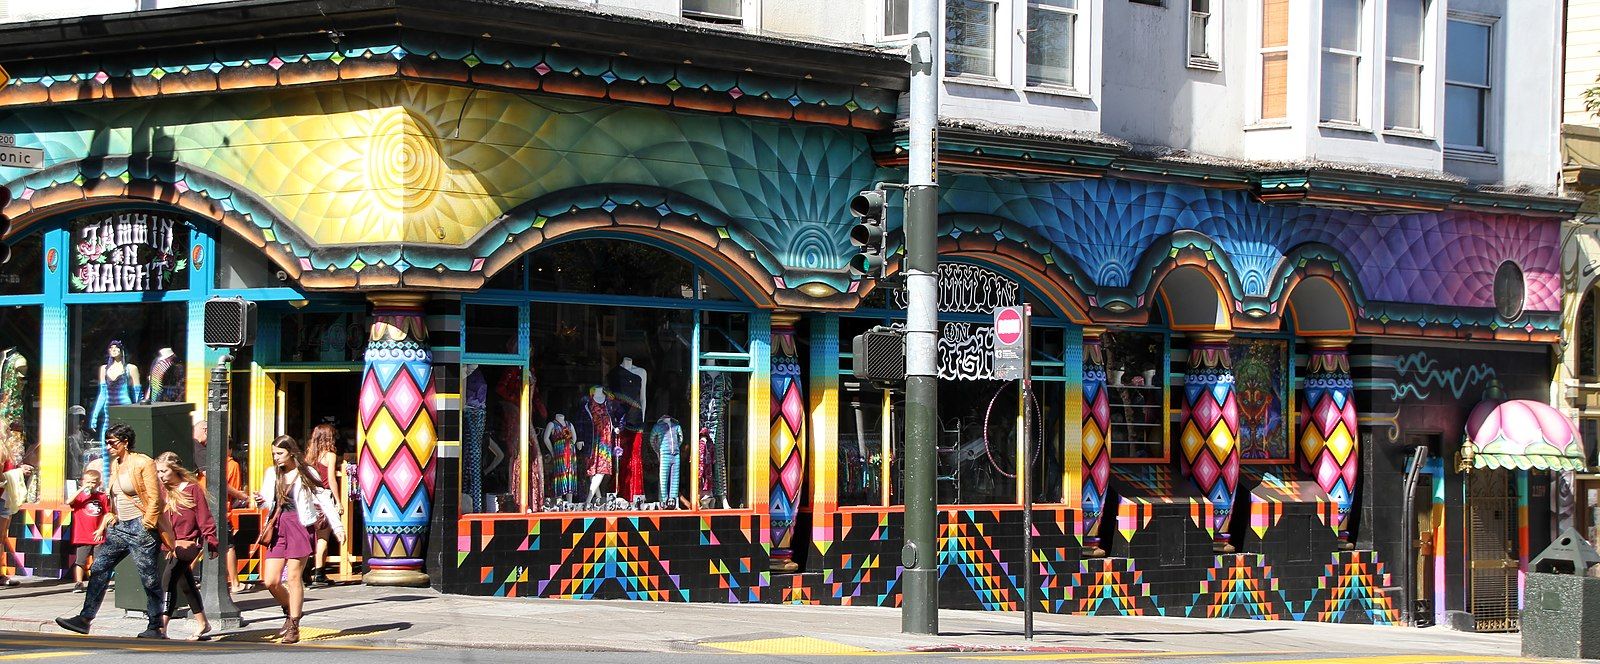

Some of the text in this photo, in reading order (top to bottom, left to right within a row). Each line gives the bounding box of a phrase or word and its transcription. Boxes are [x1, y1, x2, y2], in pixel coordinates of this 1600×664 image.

[81, 213, 175, 256] JAMMIN
[86, 260, 169, 292] HAIGHT
[943, 322, 971, 342] ON
